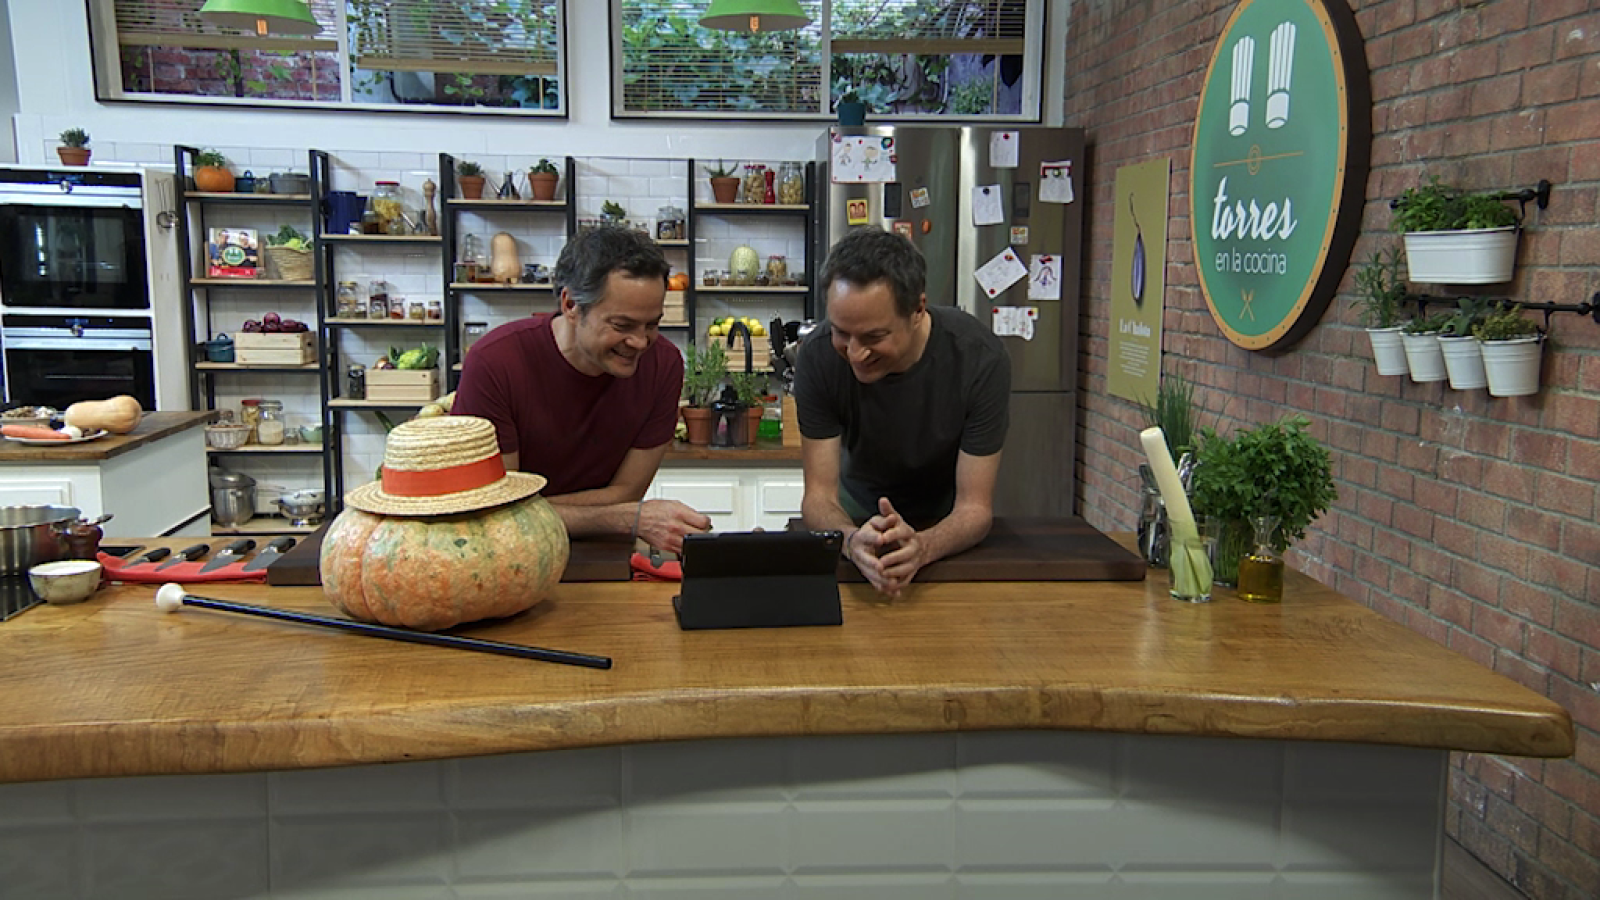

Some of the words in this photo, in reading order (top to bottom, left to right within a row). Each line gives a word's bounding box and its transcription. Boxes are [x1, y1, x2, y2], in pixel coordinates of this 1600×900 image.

[1211, 175, 1298, 241] torres
[1215, 252, 1230, 272] en
[1232, 246, 1242, 273] la
[1243, 247, 1287, 275] cocina
